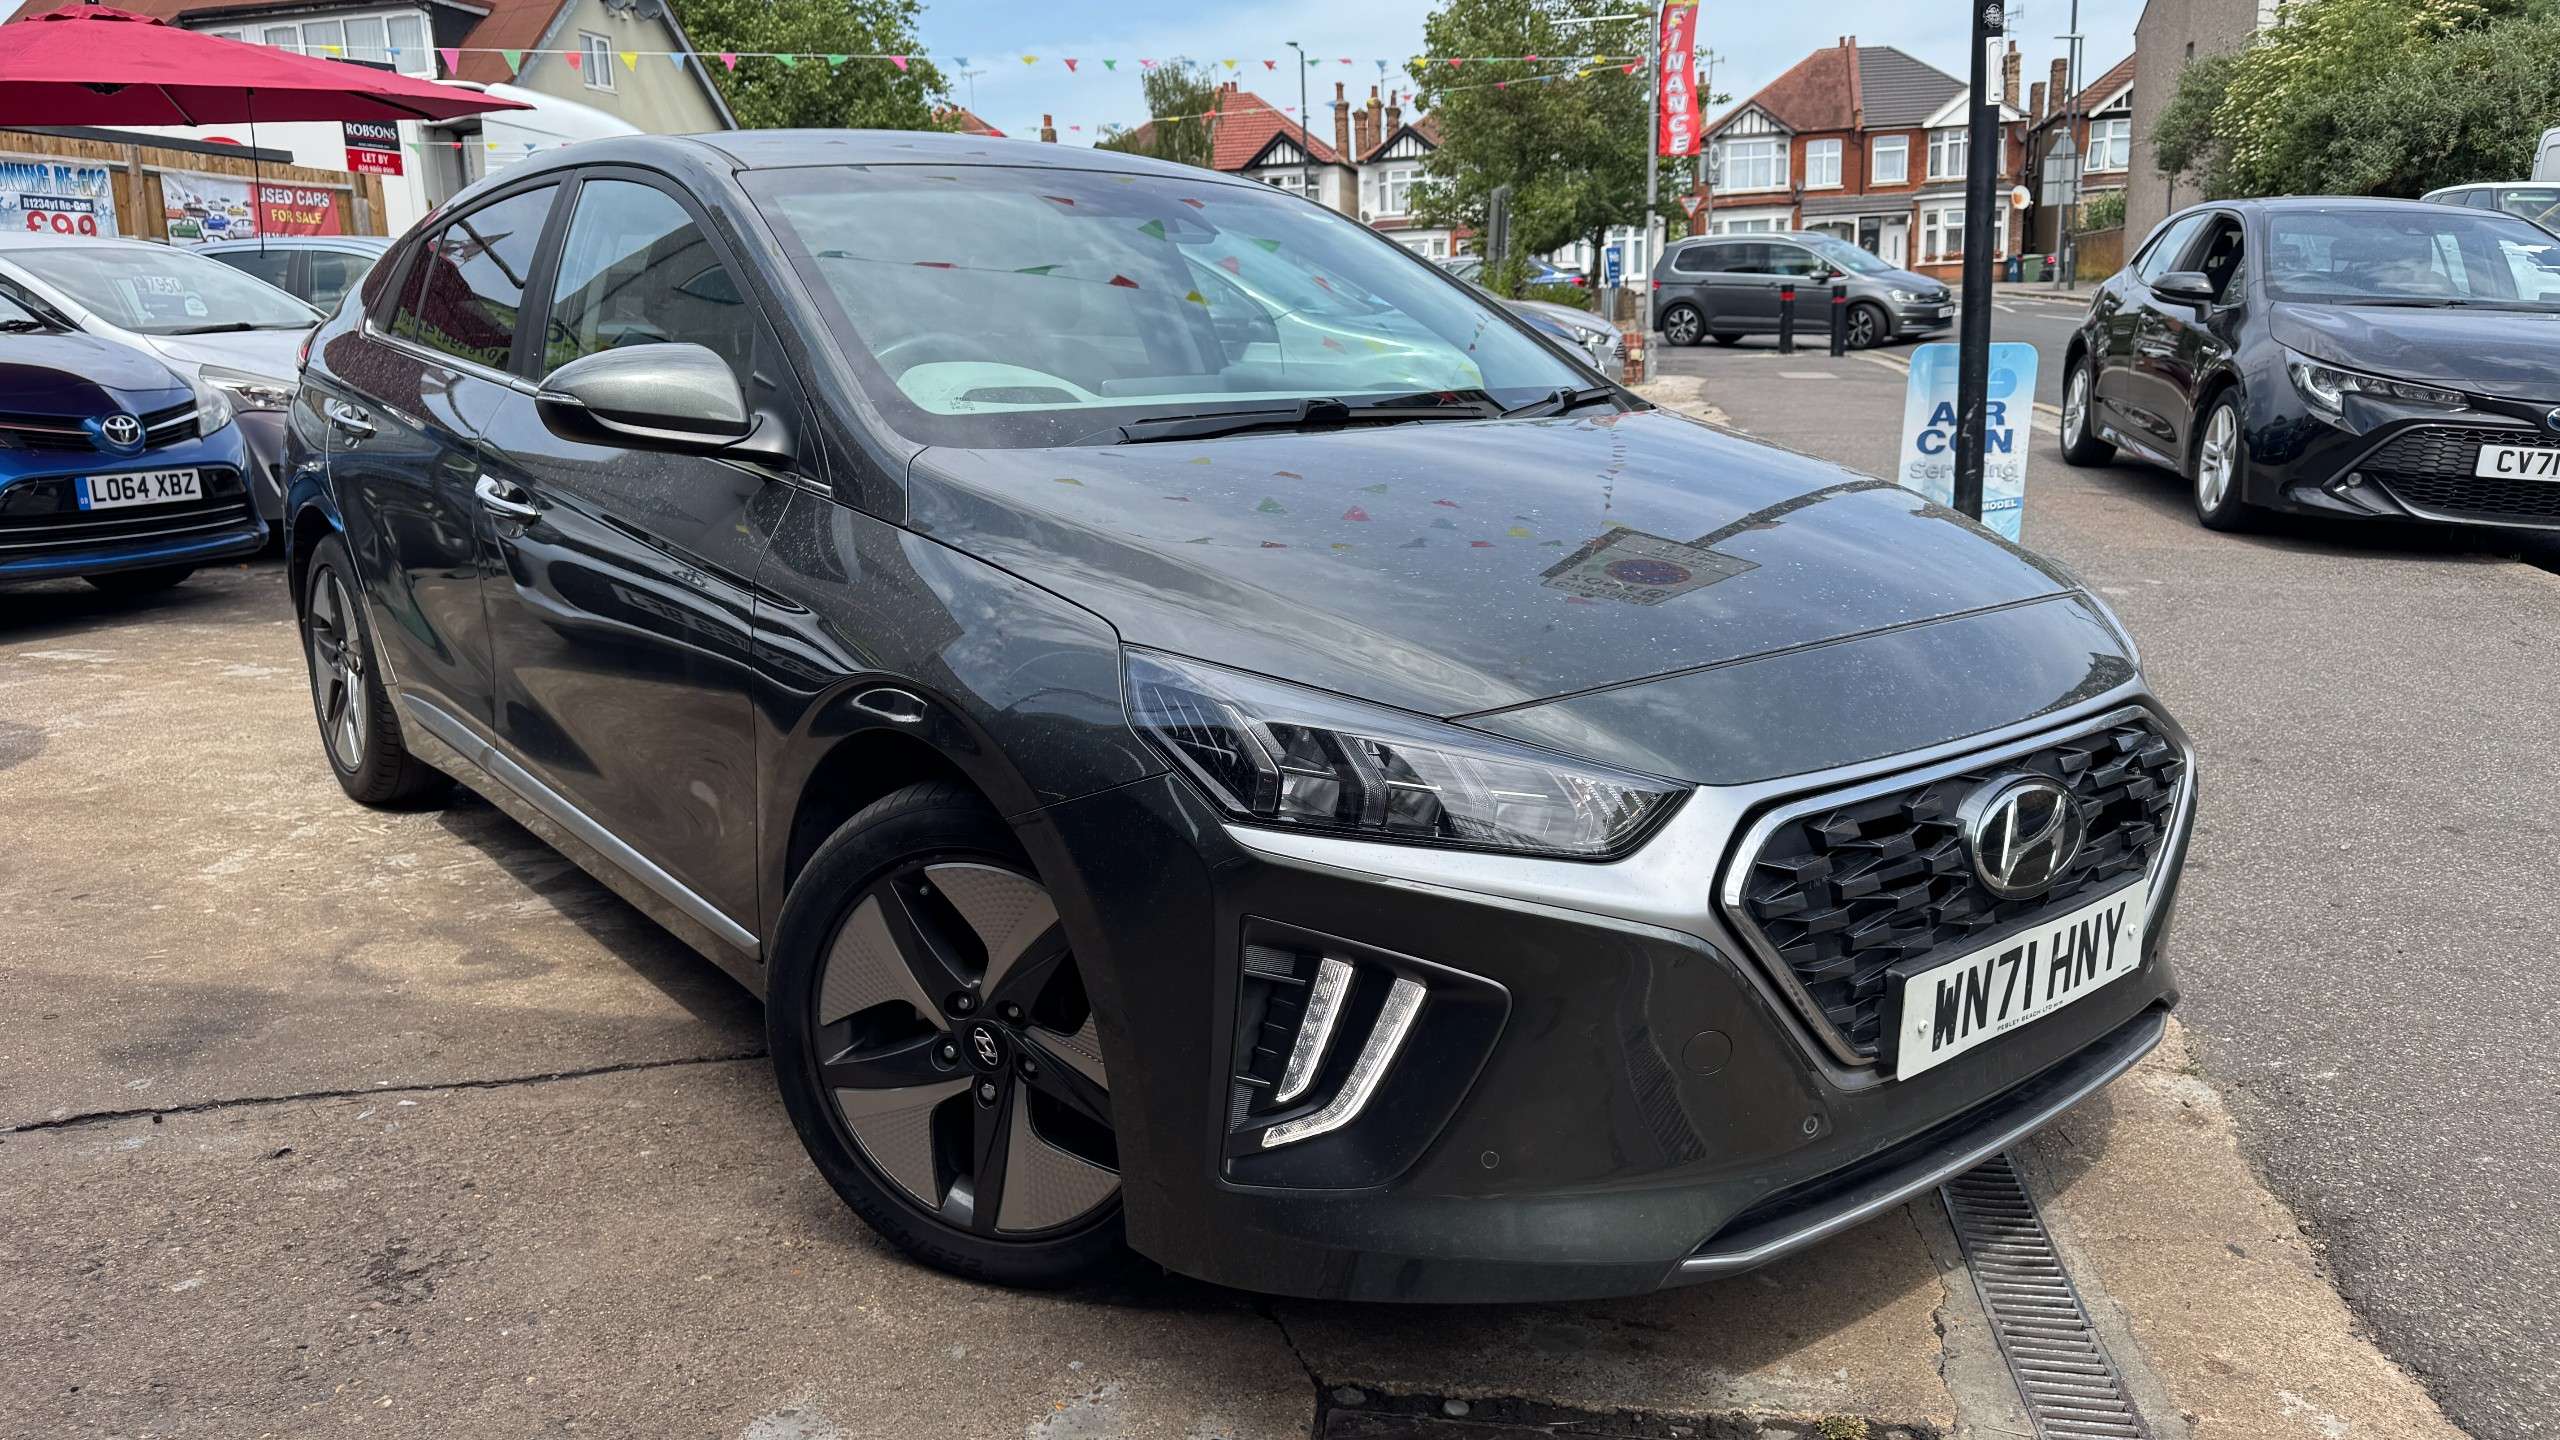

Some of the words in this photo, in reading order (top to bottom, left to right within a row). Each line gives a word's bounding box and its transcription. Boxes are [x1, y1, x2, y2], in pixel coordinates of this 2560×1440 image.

[1665, 7, 1691, 154] FINANCE
[345, 122, 397, 141] ROBSONS
[361, 152, 377, 163] LET
[377, 153, 389, 165] BY
[296, 190, 330, 208] CARS
[26, 210, 97, 237] £99
[271, 209, 293, 223] FOR
[295, 211, 323, 225] SALE
[1927, 400, 2007, 427] AR
[1916, 429, 2014, 456] CN
[90, 476, 150, 502] LO64
[154, 472, 197, 497] XBZ
[1932, 941, 2038, 1053] WN71
[2047, 901, 2127, 1001] HNY
[2021, 1008, 2042, 1022] BEACH
[2042, 1004, 2053, 1013] LTD
